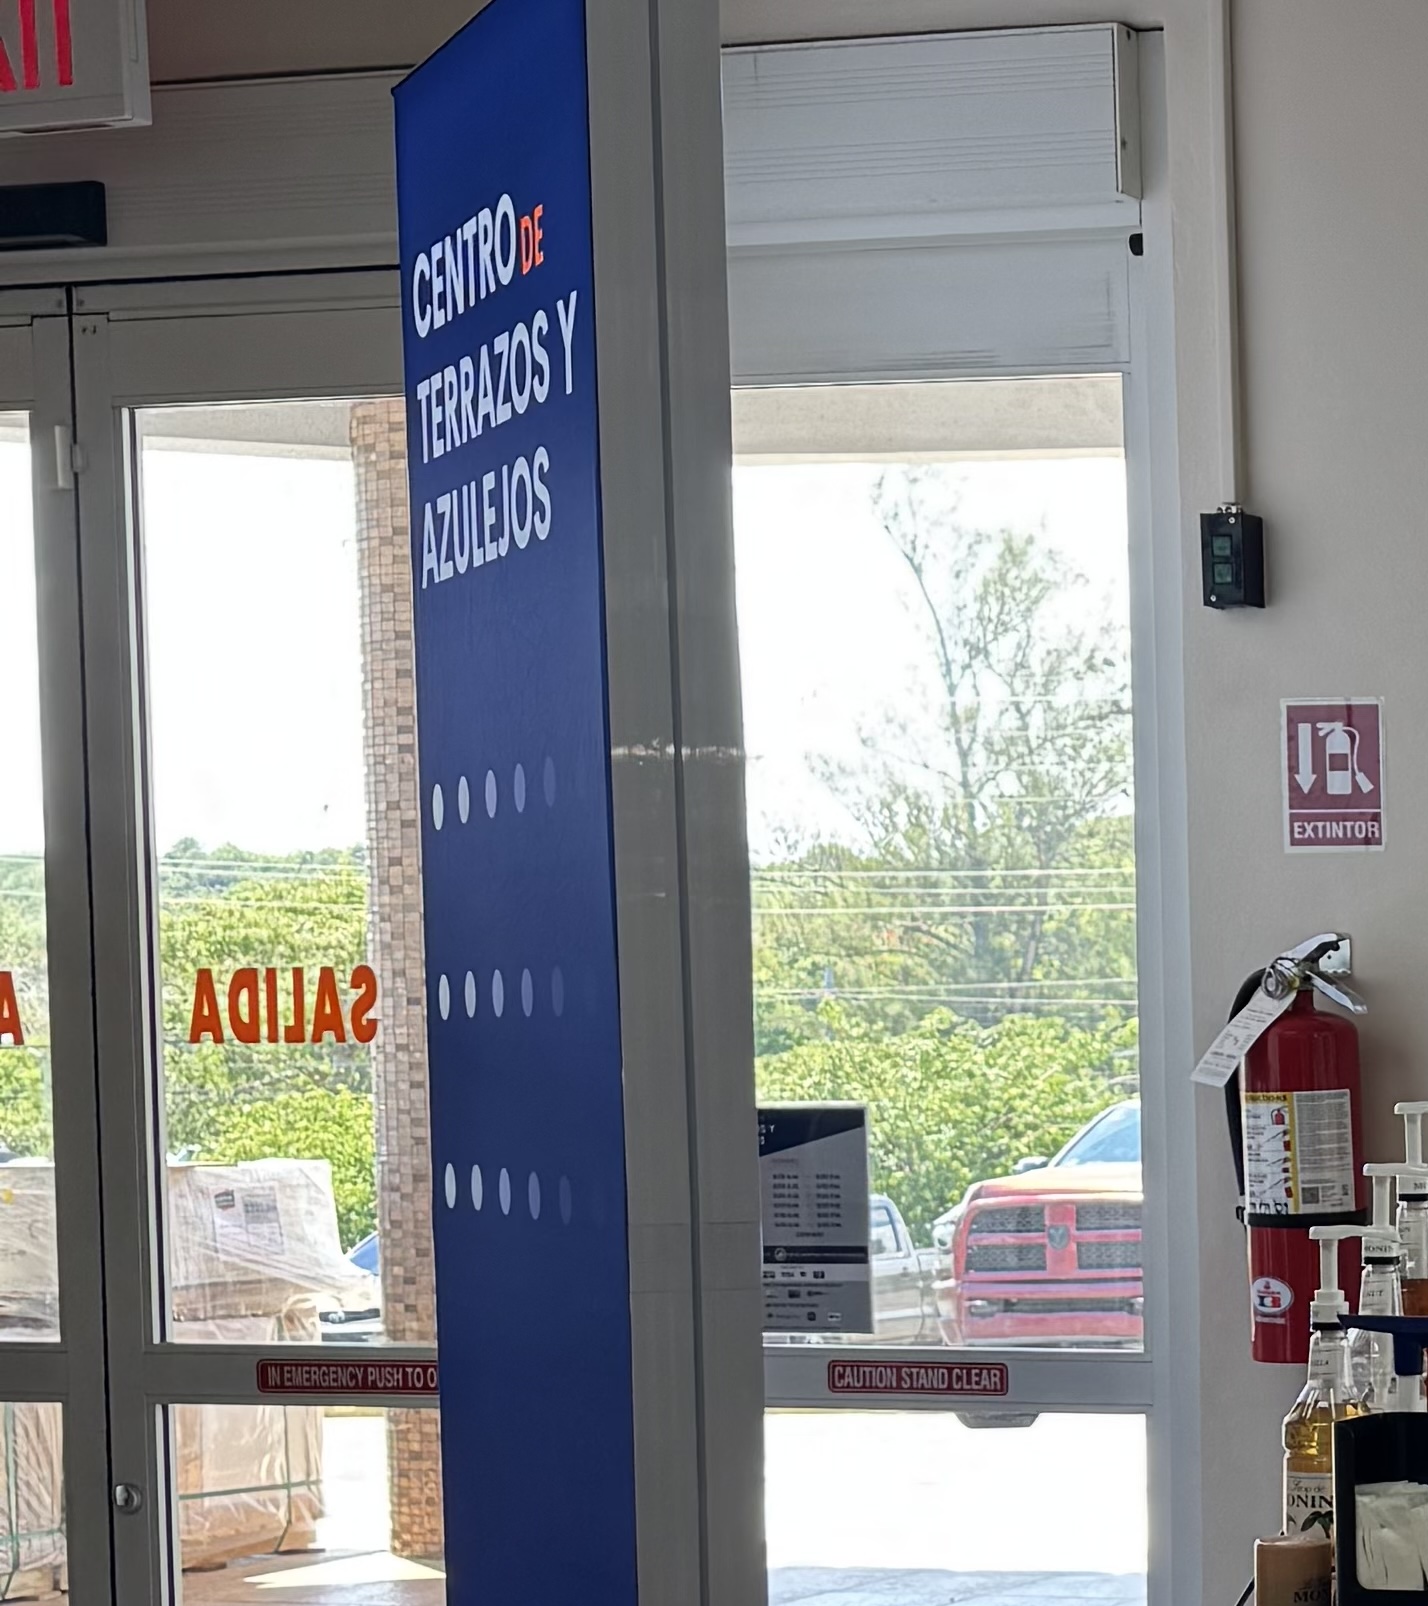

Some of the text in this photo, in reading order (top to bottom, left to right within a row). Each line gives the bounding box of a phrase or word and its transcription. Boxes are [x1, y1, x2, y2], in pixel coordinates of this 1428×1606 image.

[413, 193, 544, 338] CENTRO DE
[416, 290, 578, 464] TERRAZOS Y
[421, 446, 552, 590] AZULEJOS
[1293, 821, 1380, 839] EXTINTOR
[267, 1365, 281, 1387] IN
[283, 1365, 365, 1388] EMERGENCY
[367, 1366, 403, 1388] PUSH
[405, 1367, 424, 1388] TO
[834, 1365, 1001, 1390] CAUTION STAND CLEAR
